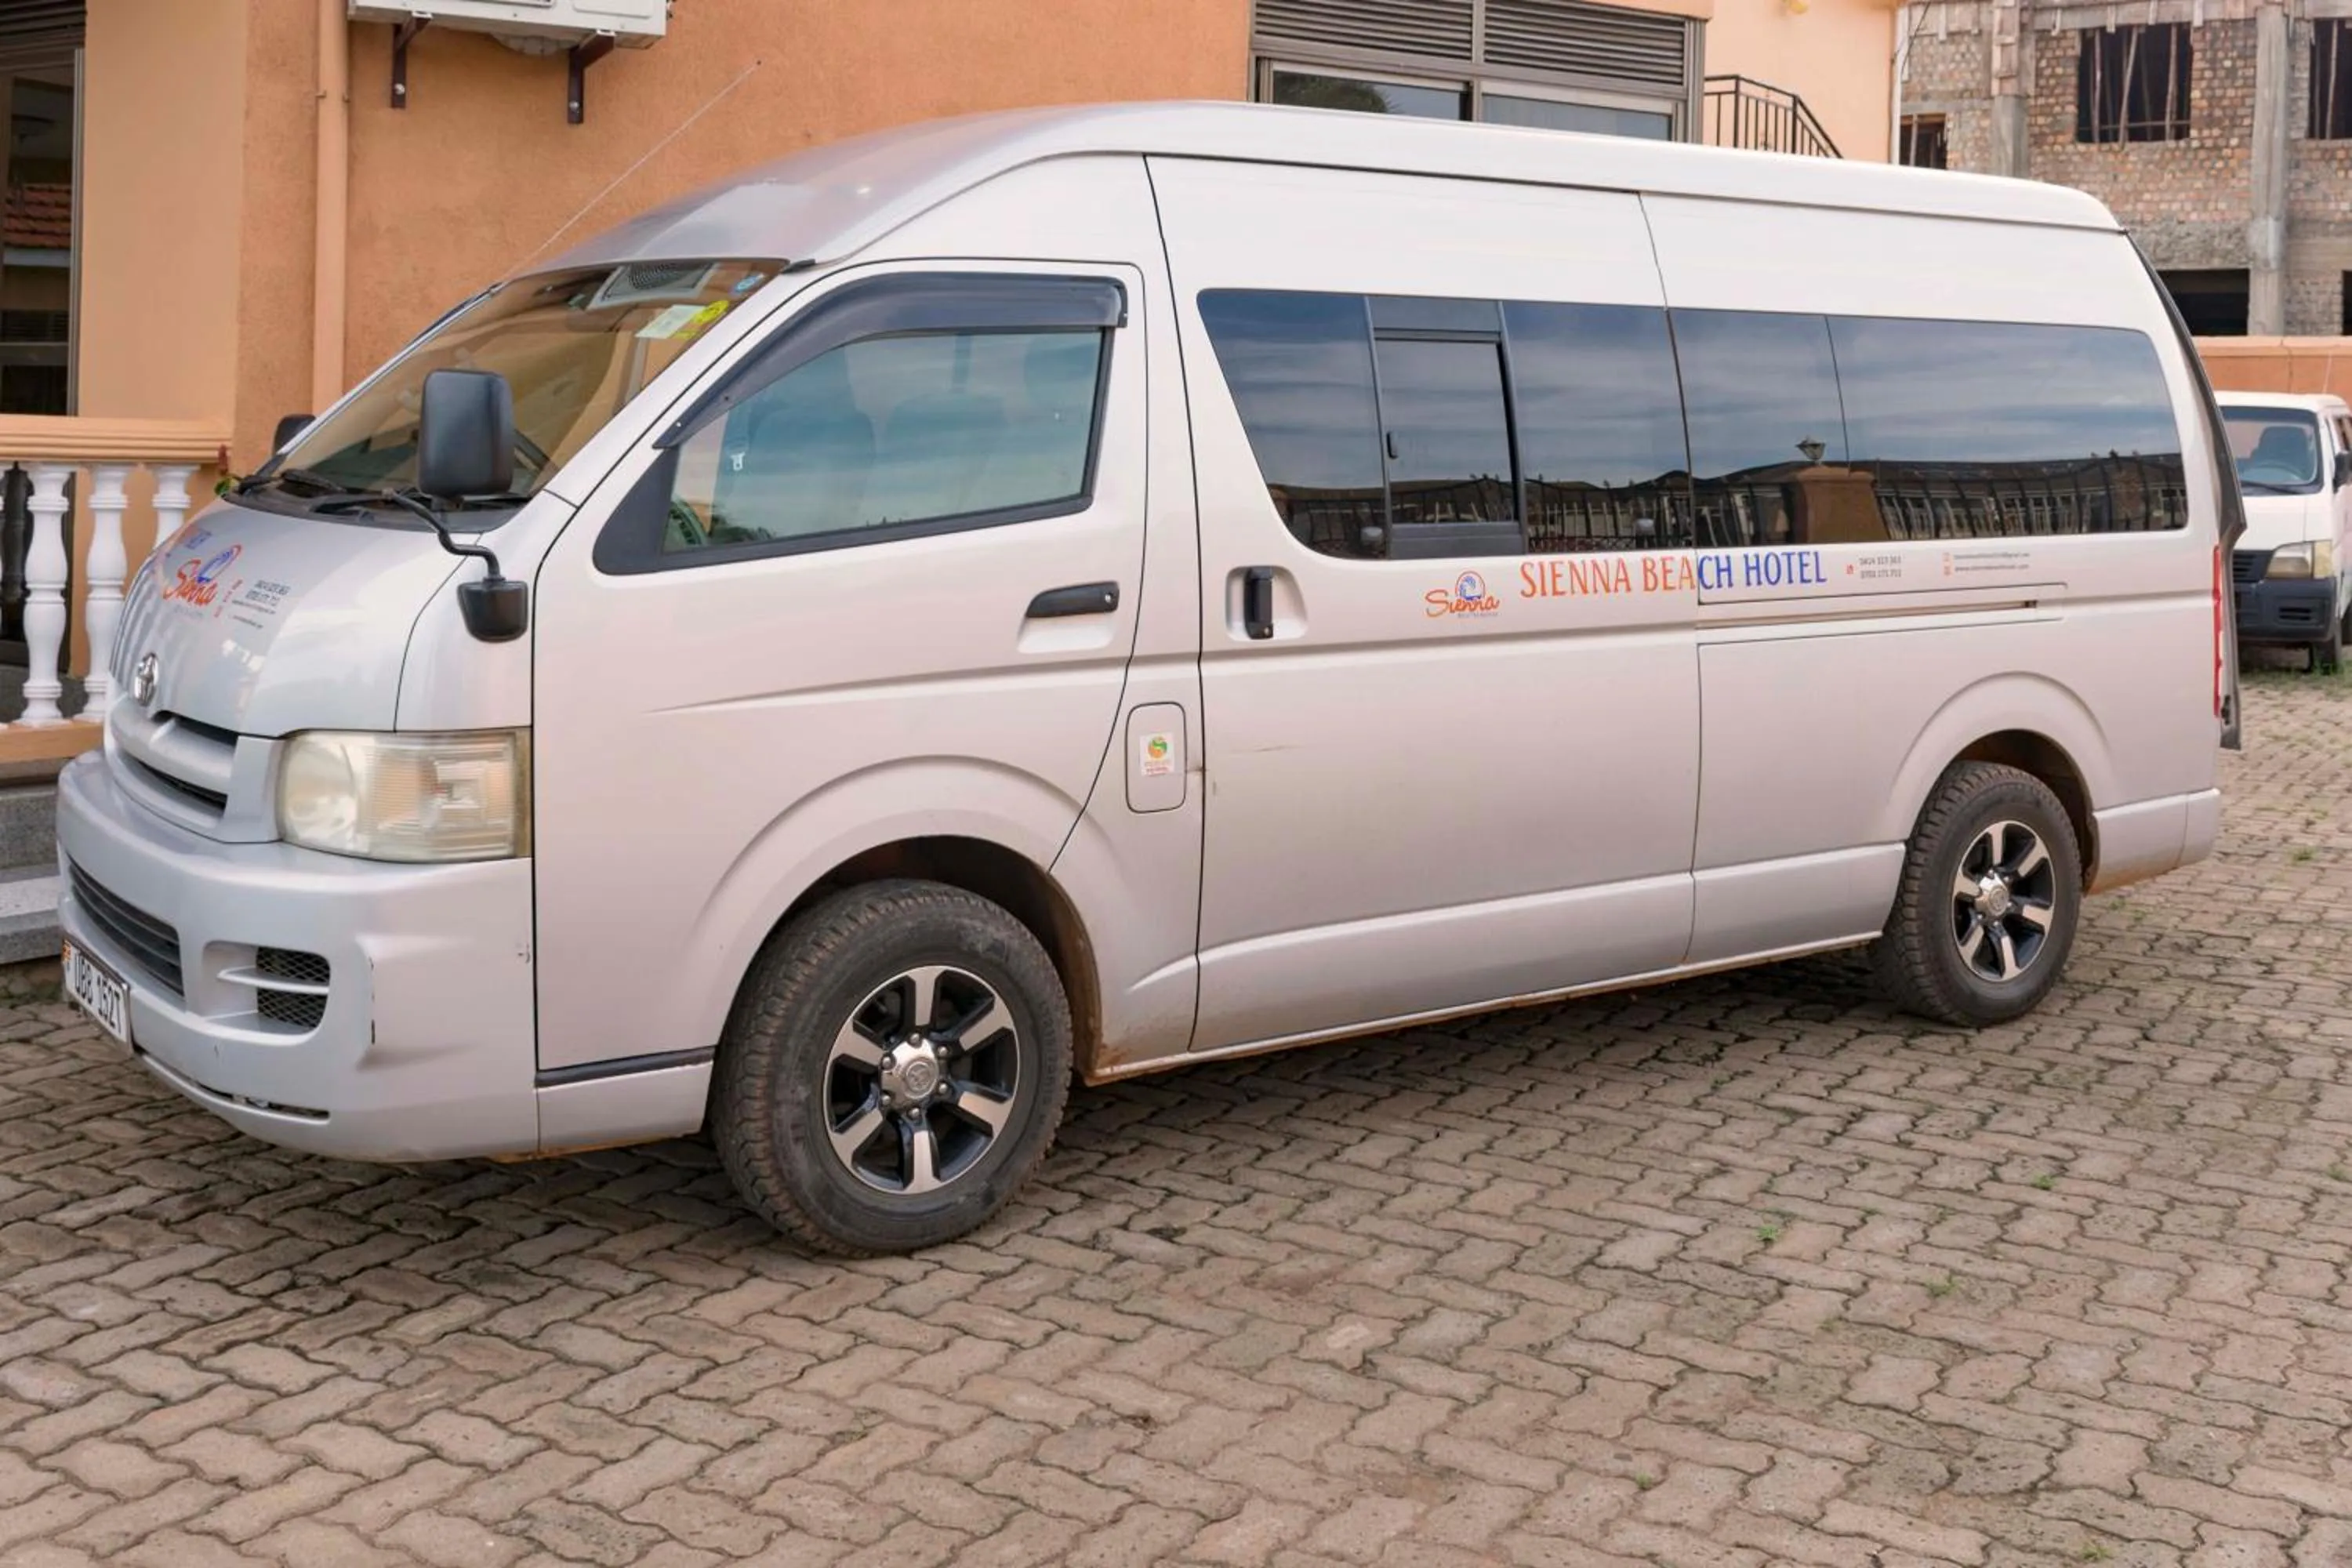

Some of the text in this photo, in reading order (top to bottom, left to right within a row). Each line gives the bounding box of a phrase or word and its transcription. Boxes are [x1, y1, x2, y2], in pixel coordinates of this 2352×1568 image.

[1519, 550, 1828, 598] SIENNA BEACH HOTEL
[1425, 589, 1501, 618] Sienna
